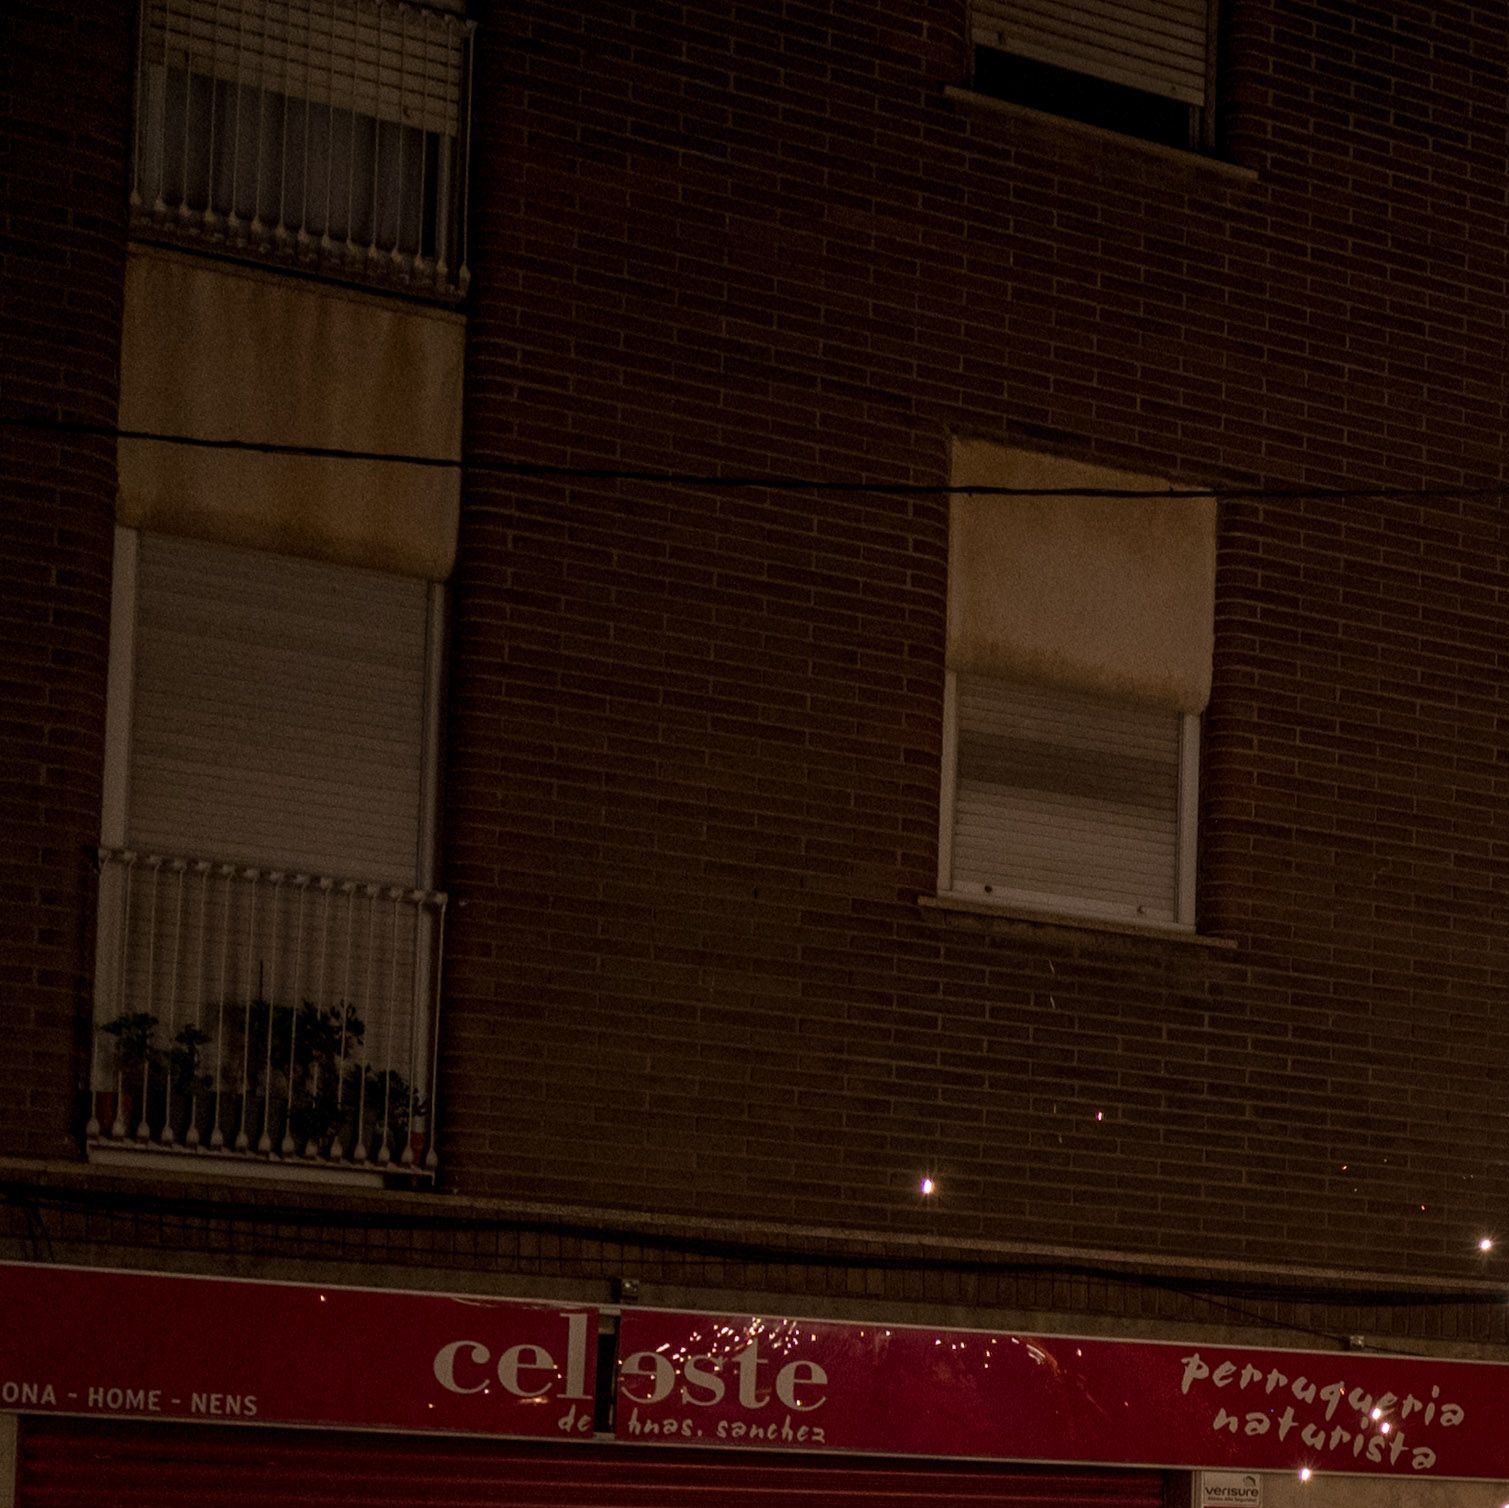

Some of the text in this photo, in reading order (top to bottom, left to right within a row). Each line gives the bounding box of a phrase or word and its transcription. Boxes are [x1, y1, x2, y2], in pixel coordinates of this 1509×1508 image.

[88, 1386, 162, 1412] HOME
[190, 1391, 259, 1417] NENS
[1181, 1352, 1465, 1422] perruqueria
[557, 1402, 827, 1444] de hnas. sanchez
[1212, 1405, 1438, 1471] naturista
[1204, 1486, 1259, 1497] verisure
